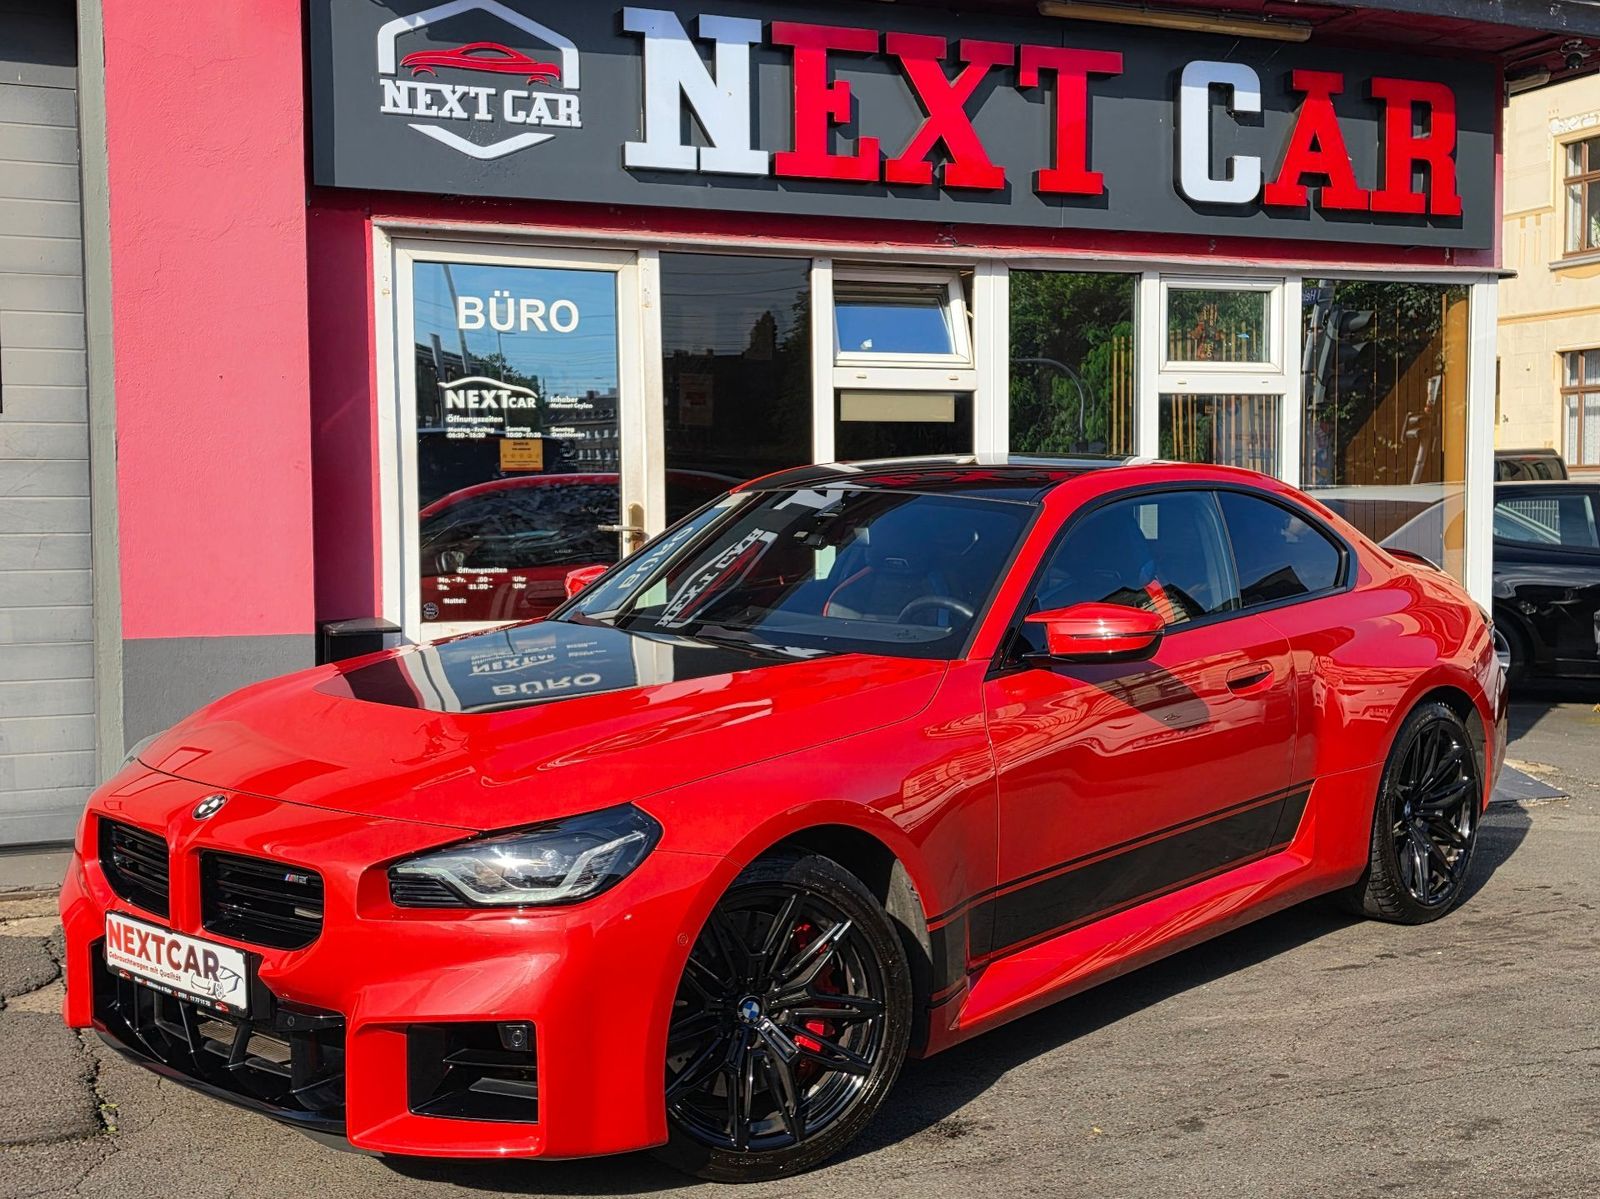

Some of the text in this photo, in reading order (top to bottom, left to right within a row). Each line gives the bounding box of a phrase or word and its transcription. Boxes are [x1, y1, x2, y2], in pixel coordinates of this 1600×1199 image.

[379, 78, 582, 128] NEXT CAR
[621, 6, 1463, 216] NEXT CAR
[458, 290, 579, 333] BÜRO
[446, 414, 503, 424] Öffnungszeiten
[108, 918, 220, 982] NEXTCAR
[108, 951, 181, 982] Gebrauchtwagen mit Qualität
